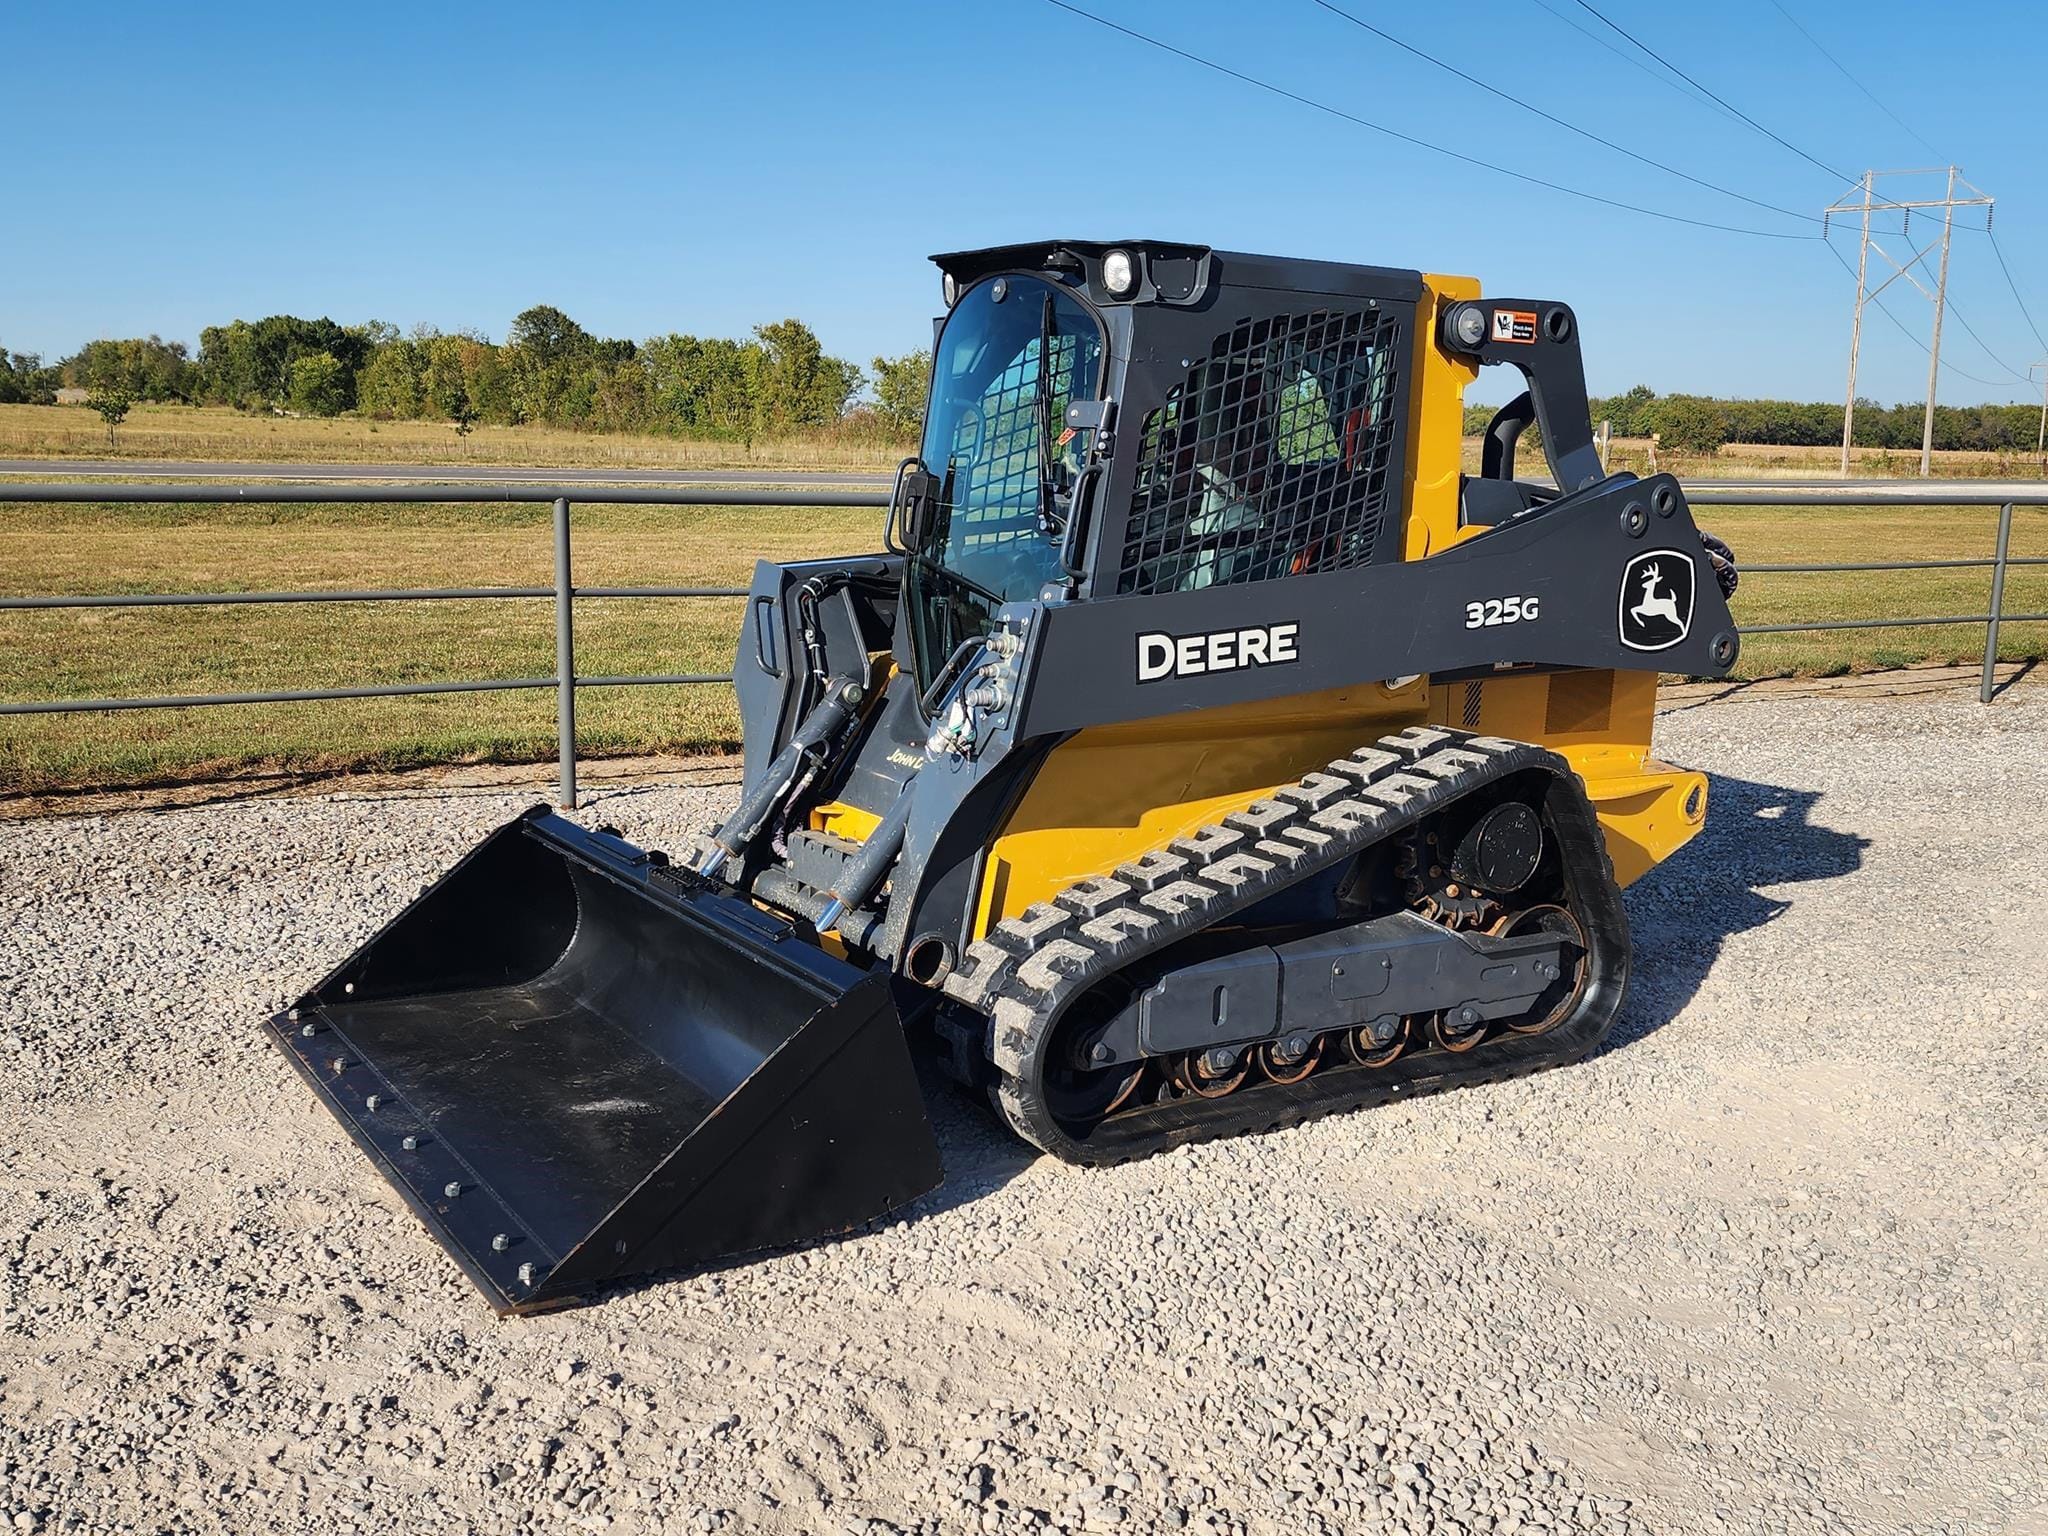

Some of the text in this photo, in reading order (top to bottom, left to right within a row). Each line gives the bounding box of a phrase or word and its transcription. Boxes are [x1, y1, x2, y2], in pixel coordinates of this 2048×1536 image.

[1465, 596, 1539, 629] 325G
[1138, 624, 1298, 681] DEERE
[886, 748, 915, 767] JOHN
